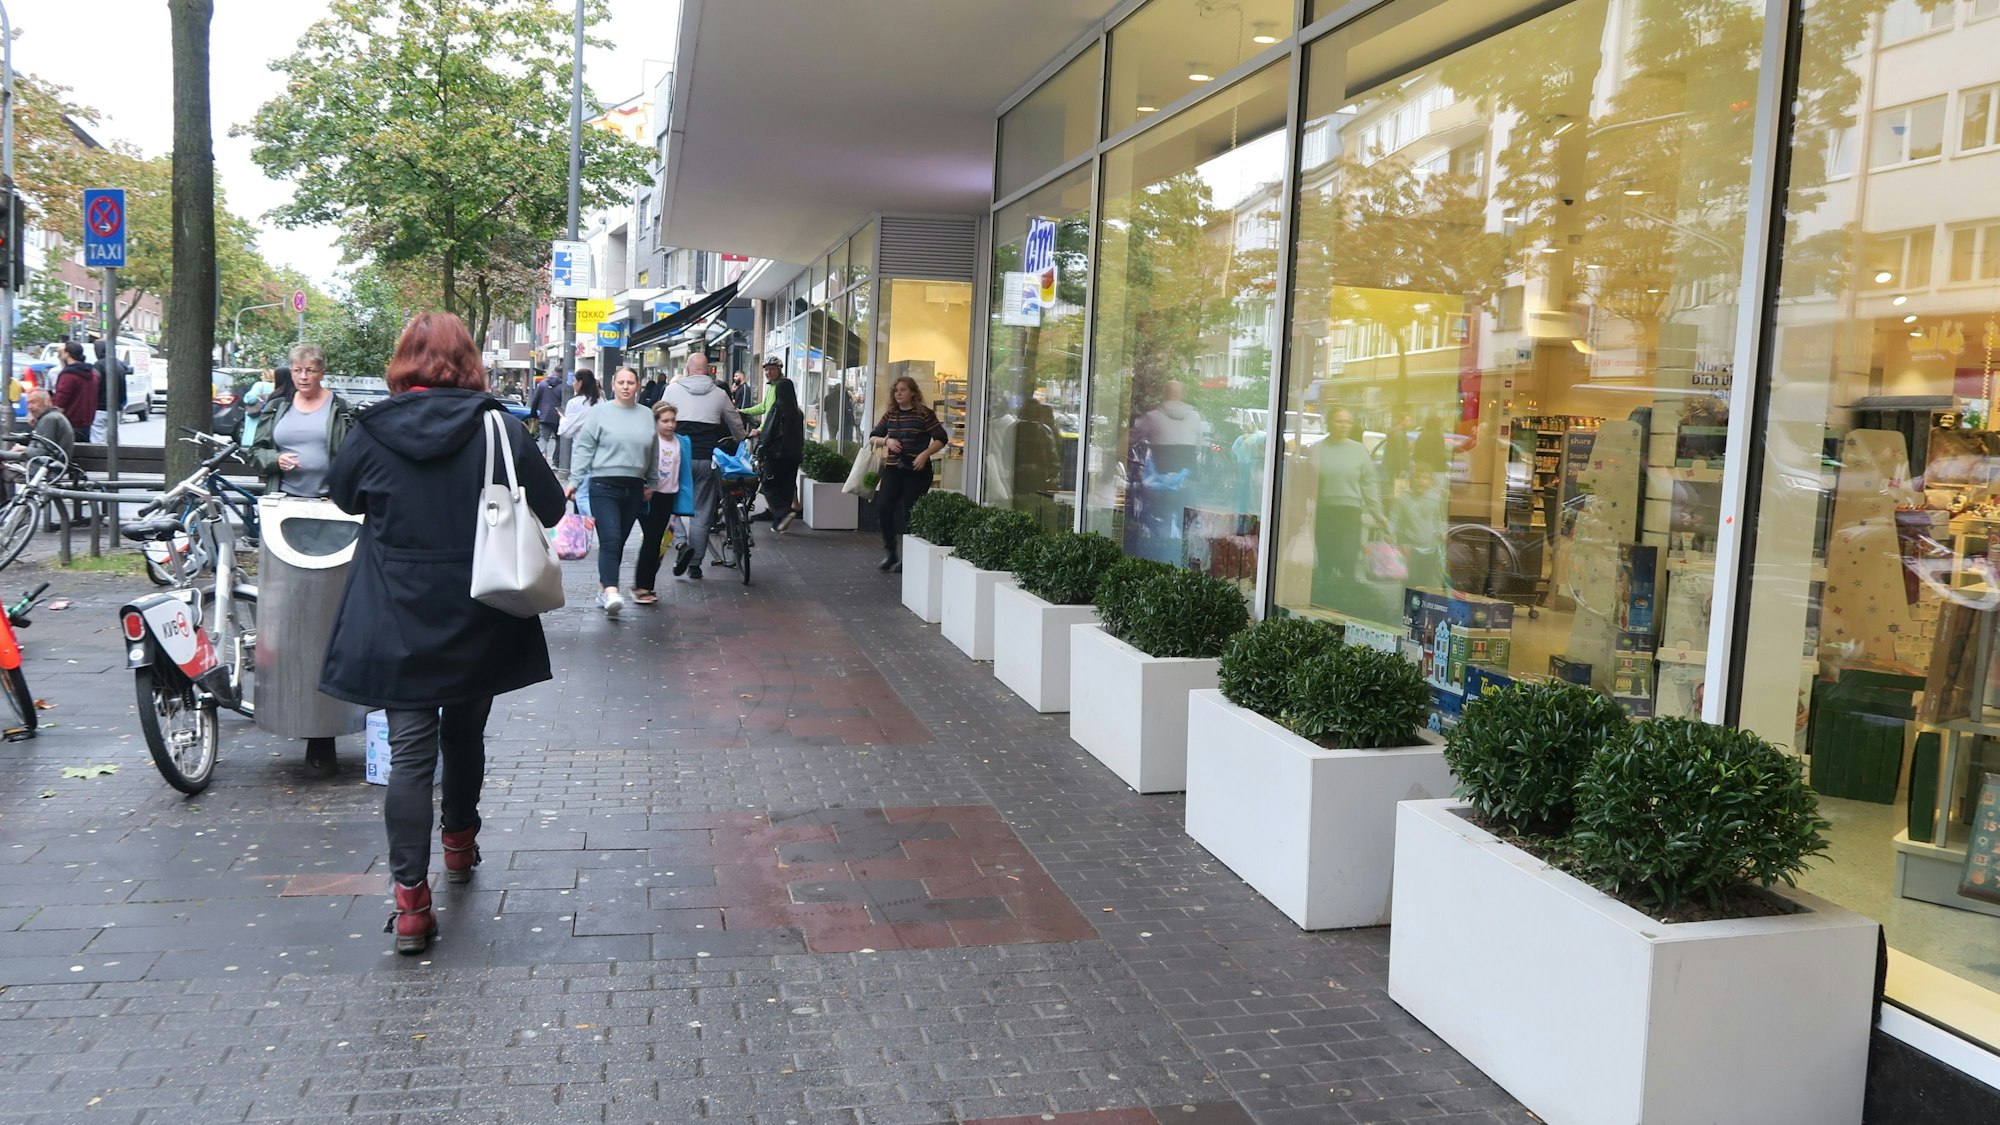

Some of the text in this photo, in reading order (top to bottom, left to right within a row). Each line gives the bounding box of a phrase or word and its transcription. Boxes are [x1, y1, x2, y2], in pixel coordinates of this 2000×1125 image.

[88, 243, 122, 260] TAXI
[1026, 220, 1053, 273] dm
[1697, 361, 1717, 372] Nur
[1692, 374, 1718, 386] Dich
[1570, 437, 1592, 445] share
[162, 620, 179, 639] KVB
[369, 764, 376, 773] 5
[1978, 836, 1988, 847] 9
